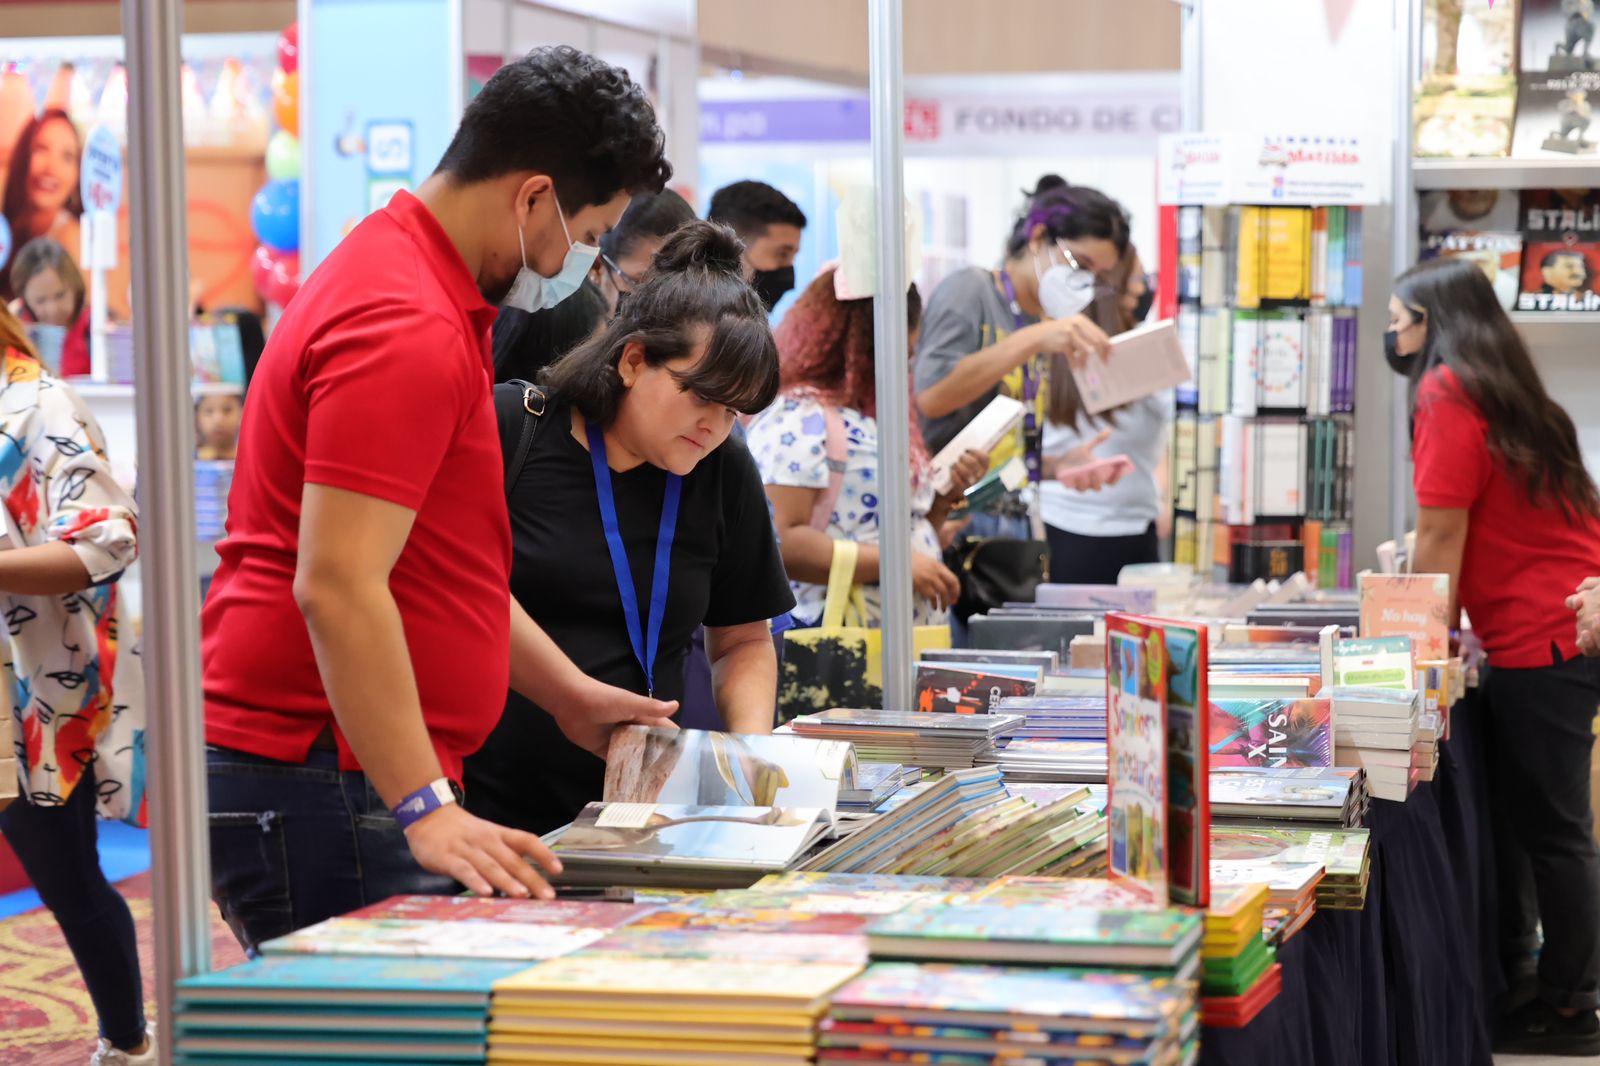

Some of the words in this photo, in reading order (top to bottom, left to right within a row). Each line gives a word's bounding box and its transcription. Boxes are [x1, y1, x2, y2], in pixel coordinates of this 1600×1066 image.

[954, 104, 1082, 134] FONDO
[1093, 105, 1138, 133] DE
[1150, 104, 1181, 133] C
[1381, 607, 1401, 623] No
[1402, 607, 1427, 626] hay
